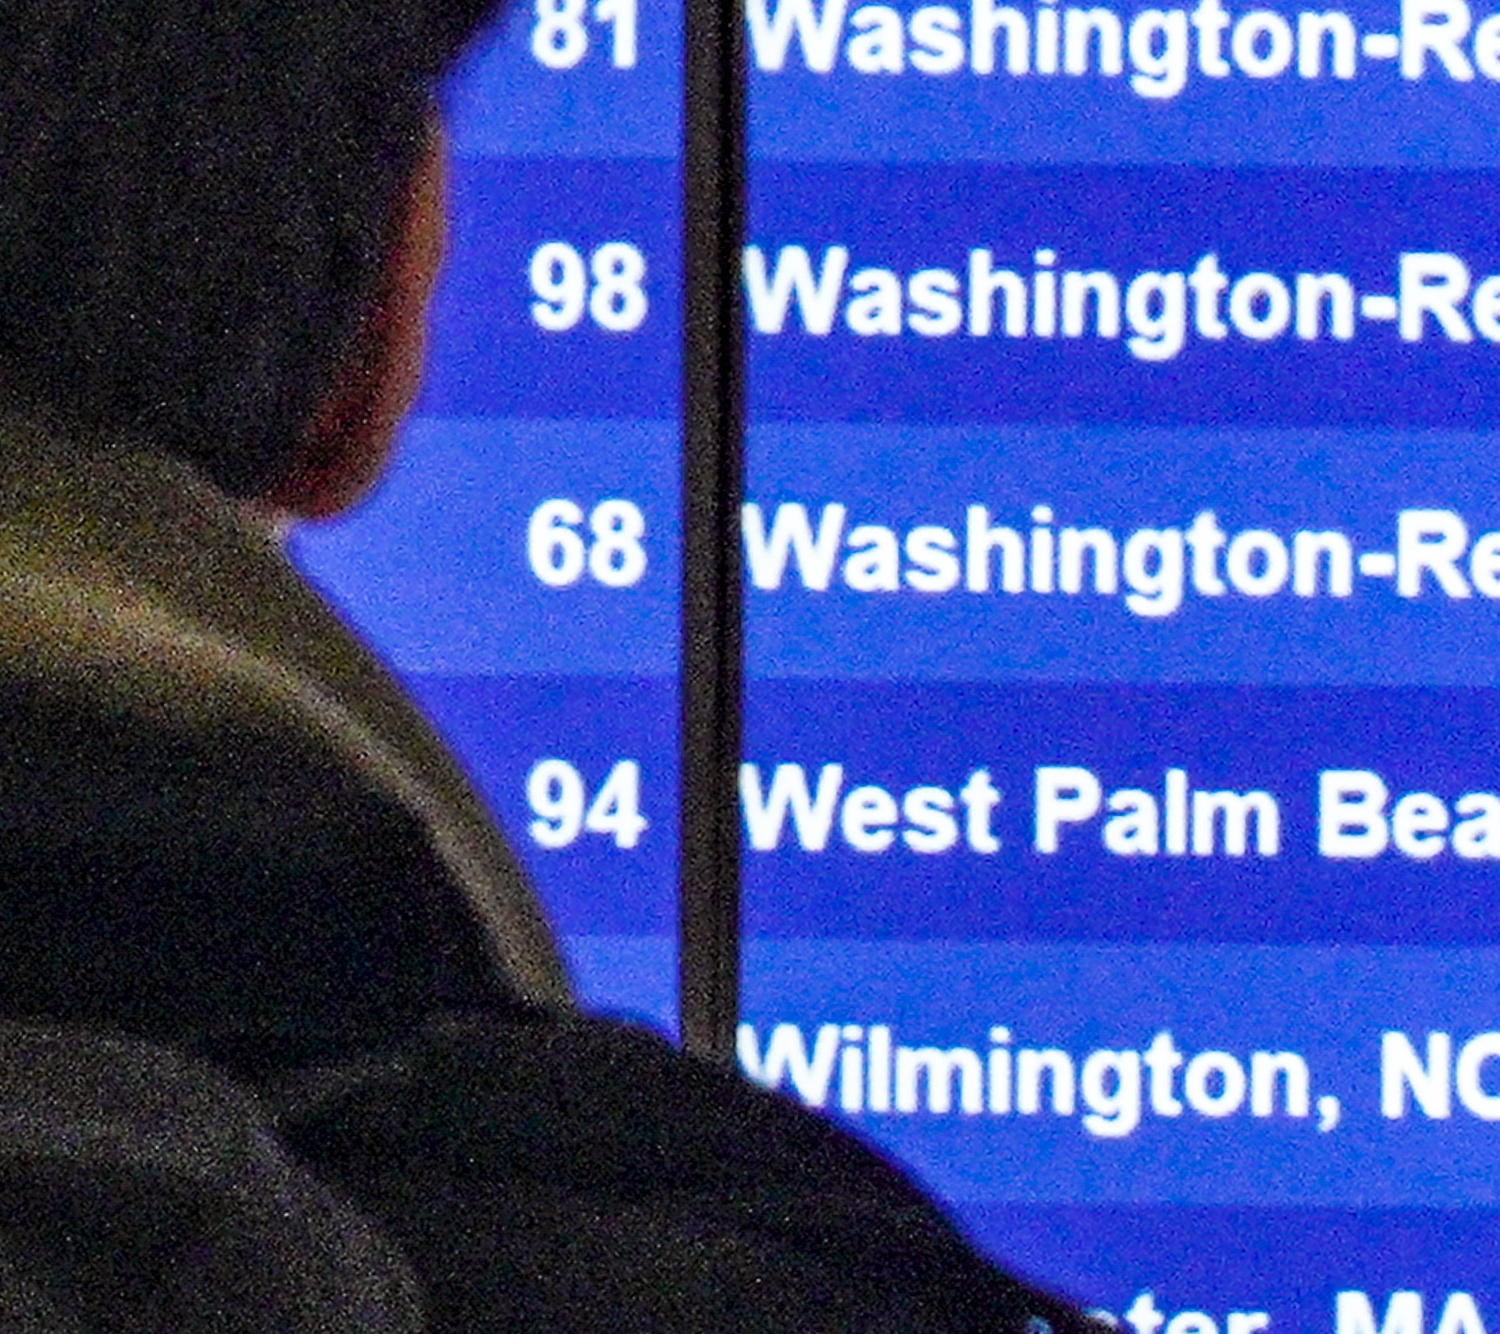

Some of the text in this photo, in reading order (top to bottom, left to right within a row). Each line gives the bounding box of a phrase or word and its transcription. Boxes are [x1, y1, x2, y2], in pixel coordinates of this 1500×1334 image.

[528, 241, 650, 333] 98
[526, 497, 649, 590] 68
[525, 758, 649, 851] 94
[737, 762, 1002, 856] West
[1034, 766, 1282, 859] Palm
[735, 1022, 1342, 1140] Wilmington,
